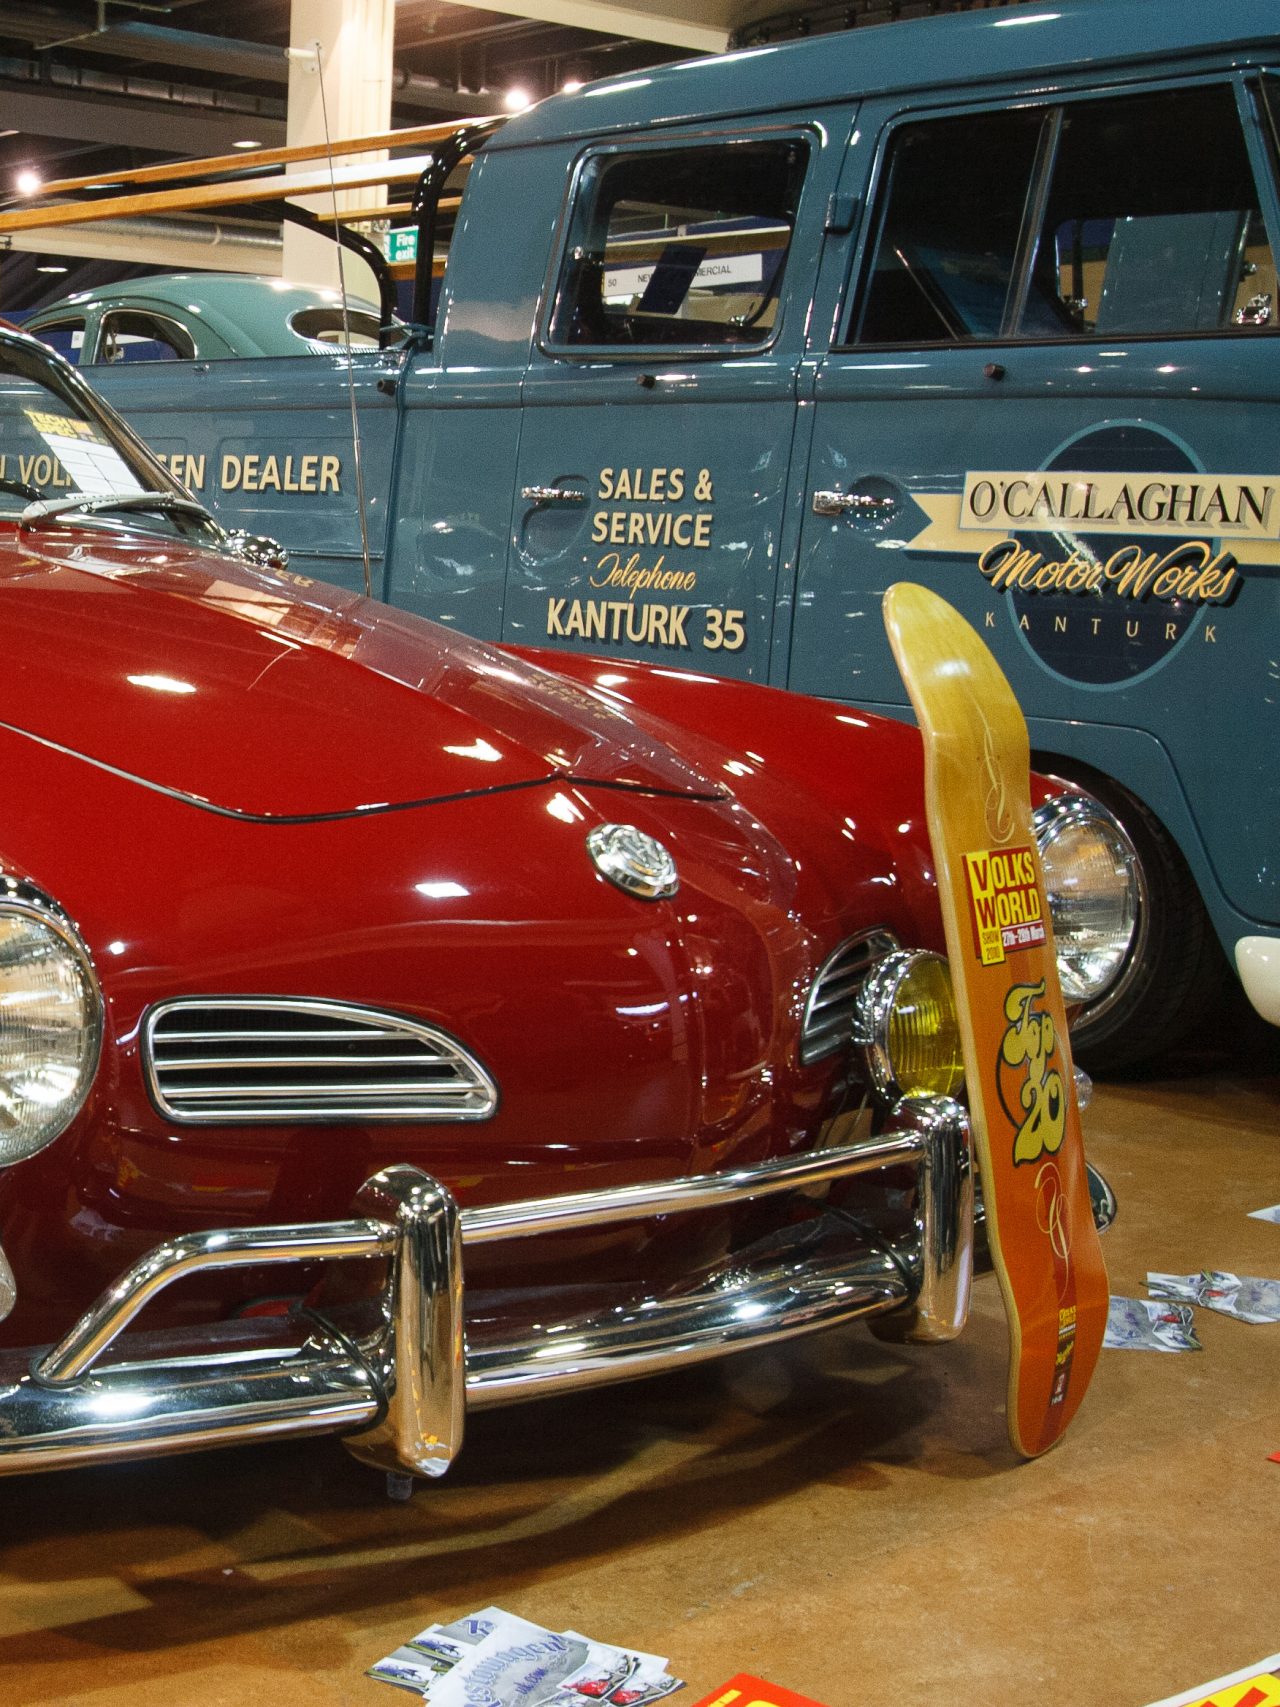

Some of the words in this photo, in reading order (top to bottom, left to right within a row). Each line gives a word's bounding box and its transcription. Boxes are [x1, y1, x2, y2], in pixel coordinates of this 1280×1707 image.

[395, 246, 415, 261] exit
[396, 233, 416, 247] Fire
[221, 454, 341, 492] DEALER
[597, 467, 685, 501] SALES
[693, 468, 713, 501] &
[968, 480, 1270, 527] O'CALLAGHAN
[591, 511, 713, 547] SERVICE
[589, 552, 696, 600] Telephone
[977, 539, 1104, 592] Motor
[1104, 540, 1238, 600] Works
[546, 597, 689, 646] KANTURK
[702, 608, 745, 650] 35
[984, 611, 1217, 643] KANTURK
[971, 850, 1036, 893] VOLKS
[975, 887, 1041, 928] WORLD
[982, 930, 1000, 945] SHOW
[1002, 976, 1055, 1074] Top
[1013, 1072, 1067, 1166] 20
